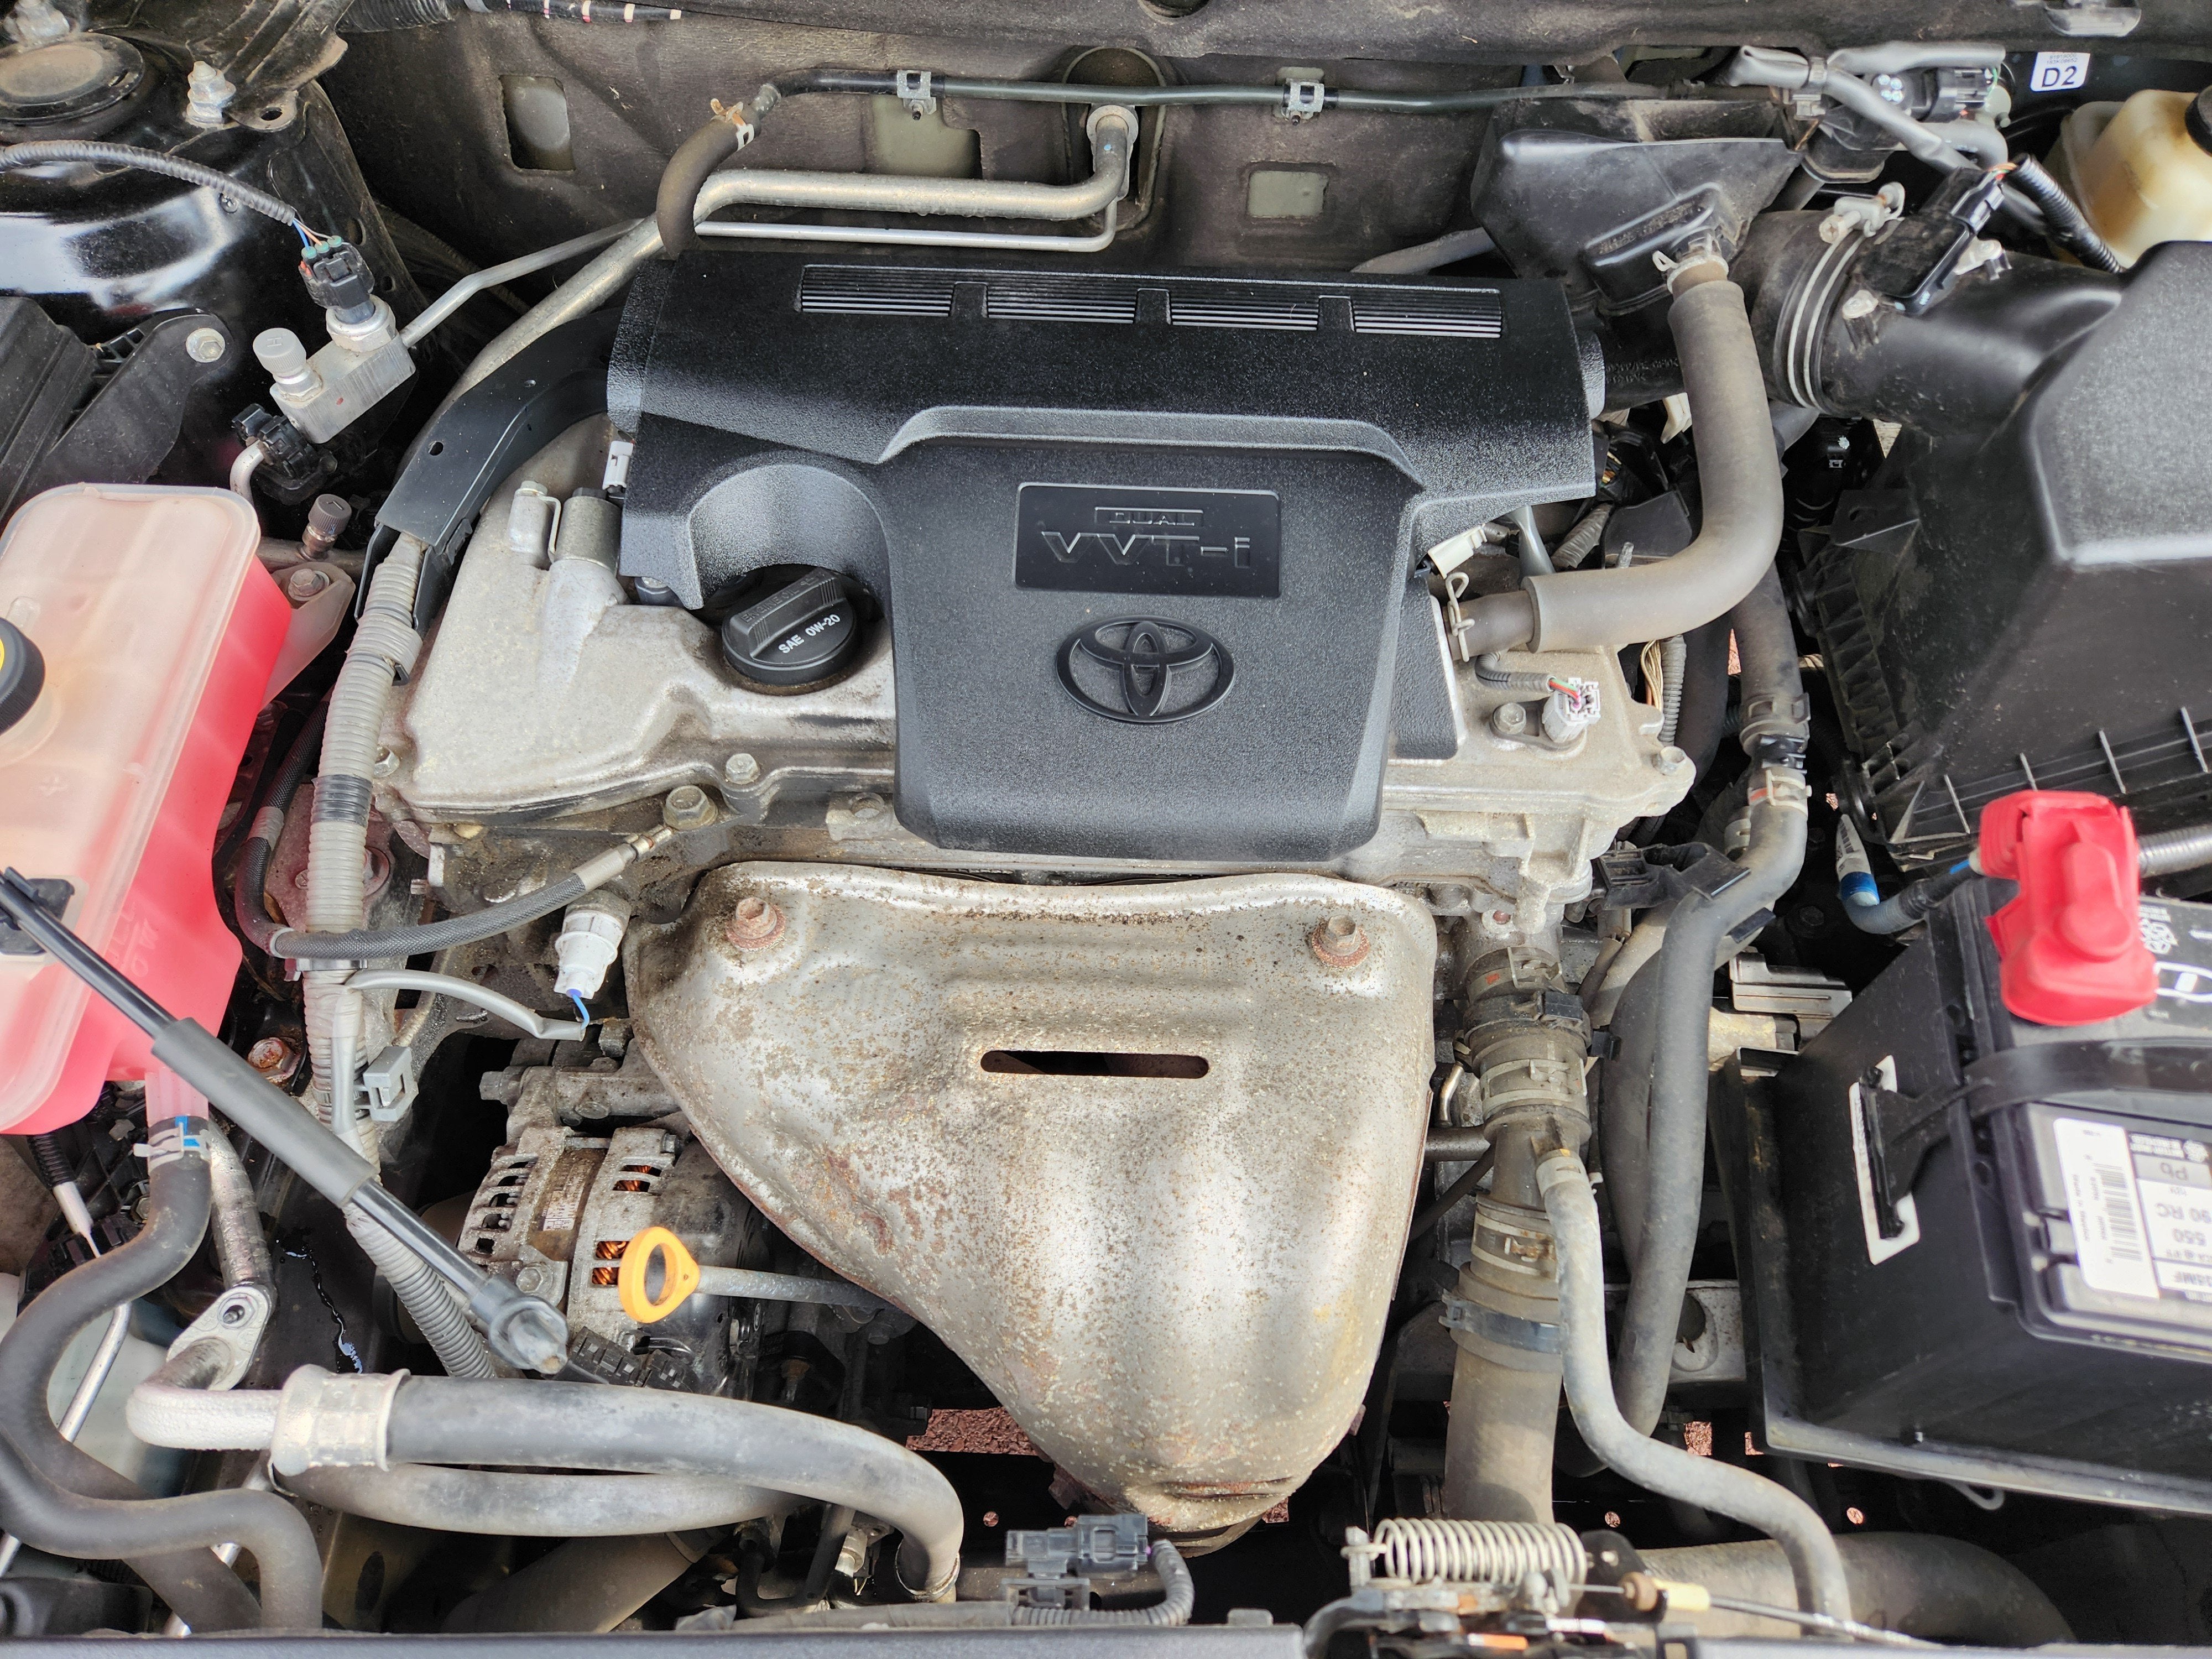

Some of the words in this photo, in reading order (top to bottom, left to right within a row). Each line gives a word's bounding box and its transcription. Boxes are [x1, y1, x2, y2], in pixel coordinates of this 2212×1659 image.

[2042, 65, 2077, 87] D2
[267, 337, 282, 347] H
[1109, 512, 1195, 527] DUAL
[1041, 531, 1251, 568] VVT-i
[741, 596, 782, 622] ENGINE
[781, 589, 800, 599] OIL
[779, 634, 804, 653] SAE
[805, 614, 841, 636] 0W-20
[2160, 1162, 2189, 1181] Pb
[2156, 1202, 2184, 1220] RC
